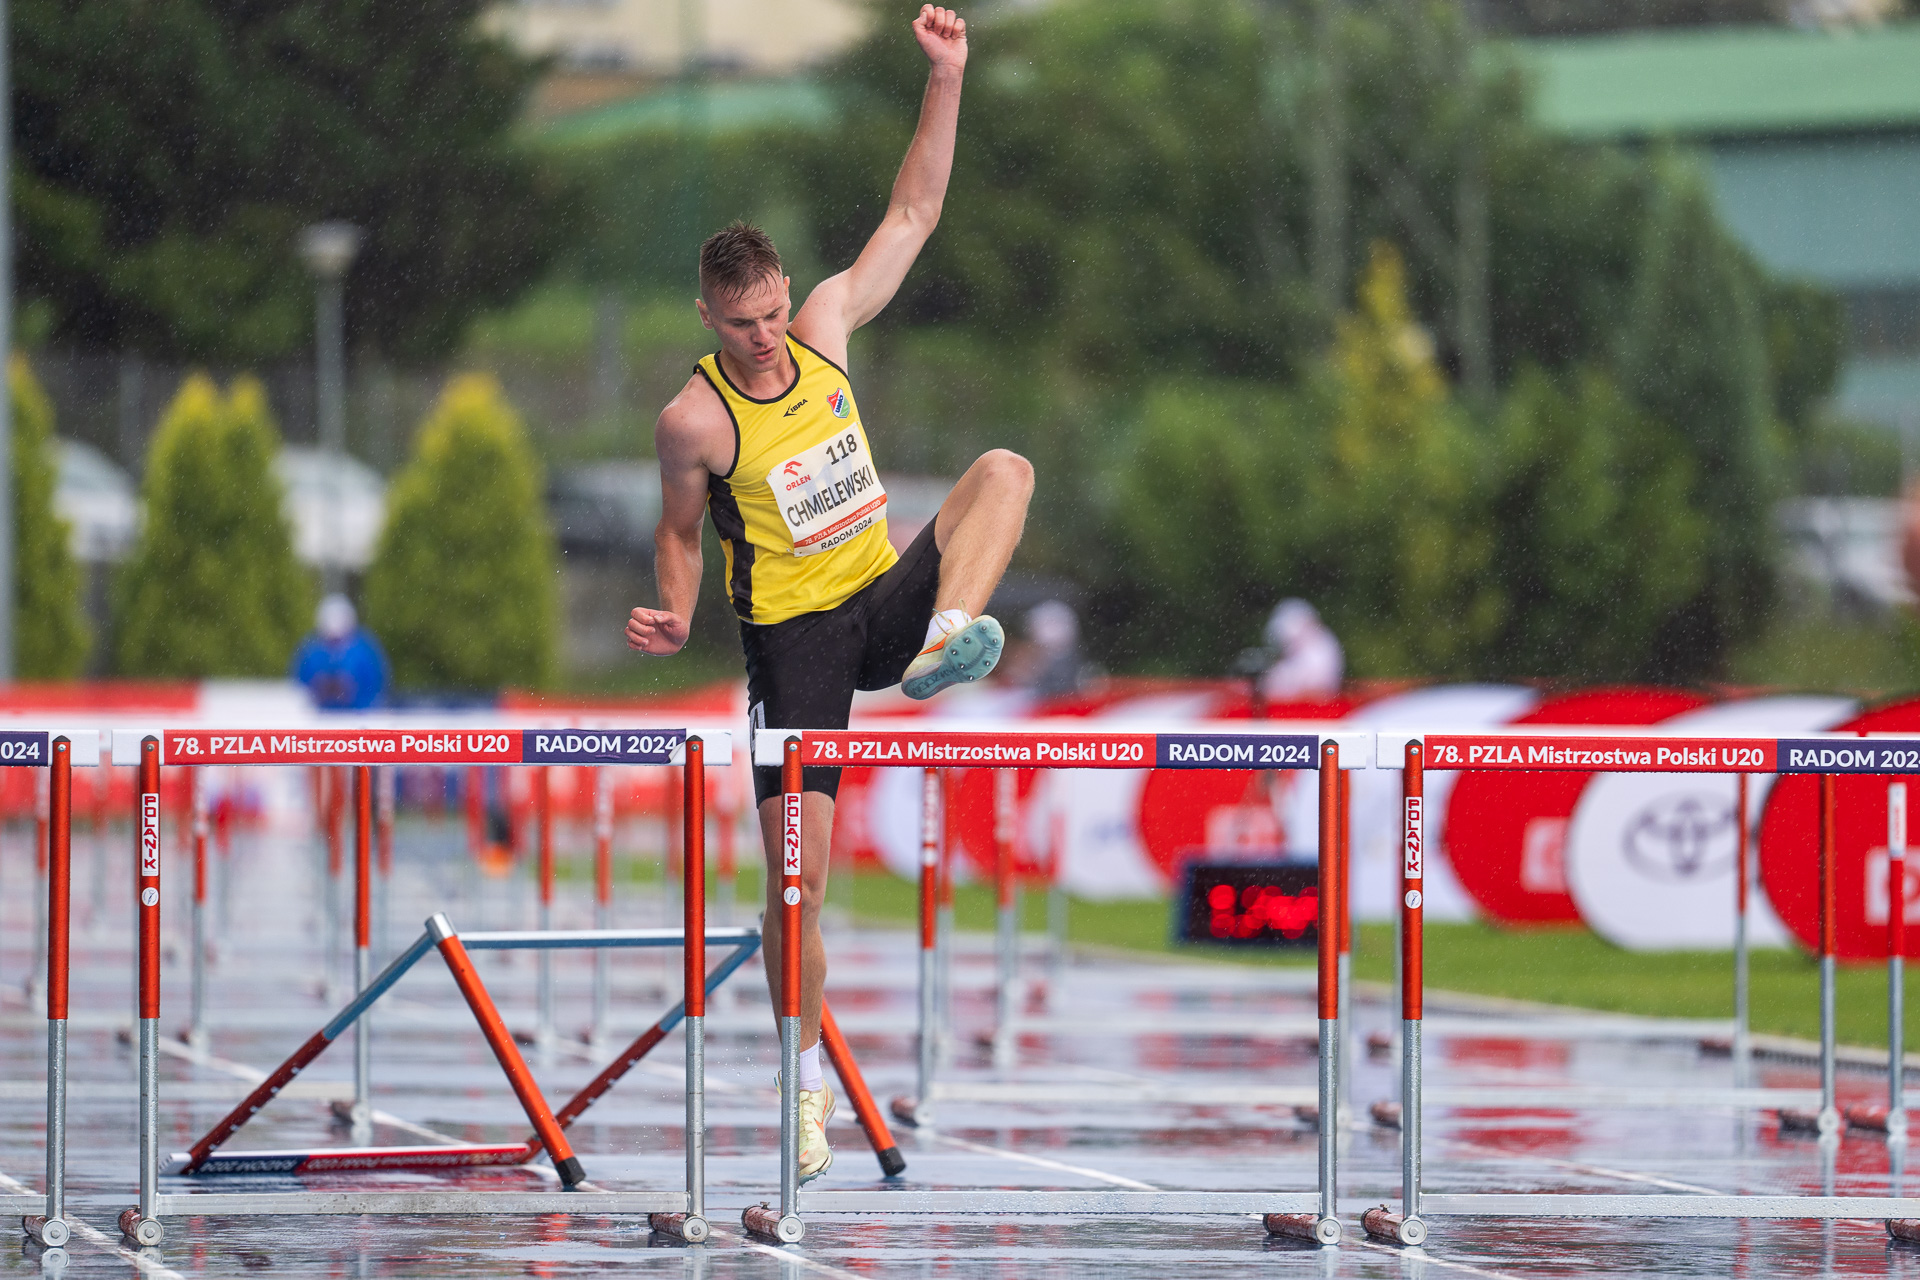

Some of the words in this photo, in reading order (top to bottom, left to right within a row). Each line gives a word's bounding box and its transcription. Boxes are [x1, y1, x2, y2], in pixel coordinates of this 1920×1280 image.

[825, 433, 858, 466] 118
[785, 474, 812, 492] ORLEN
[786, 464, 875, 527] CHMIELEWSKI
[820, 529, 854, 550] RADOM
[853, 516, 873, 534] 2024
[172, 737, 205, 756] 78.
[209, 735, 267, 755] PZLA
[269, 735, 396, 754] Mistrzostwa
[401, 734, 462, 753] Polski
[467, 734, 510, 753] U20
[535, 735, 621, 754] RADOM
[626, 735, 678, 754] 2024
[811, 740, 843, 759] 78.
[848, 740, 903, 759] PZLA
[907, 741, 1031, 760] Mistrzostwa
[1036, 742, 1096, 761] Polski
[1101, 743, 1144, 761] U20
[1168, 743, 1254, 763] RADOM
[1259, 744, 1311, 763] 2024
[1432, 745, 1464, 764] 78.
[1468, 745, 1524, 764] PZLA
[1527, 745, 1652, 765] Mistrzostwa
[1657, 747, 1717, 766] Polski
[1721, 748, 1765, 766] U20
[1789, 749, 1875, 768] RADOM
[1880, 750, 1920, 768] 202
[143, 795, 157, 870] POLANIK
[785, 795, 800, 869] POLANIK
[1406, 799, 1420, 872] POLANIK
